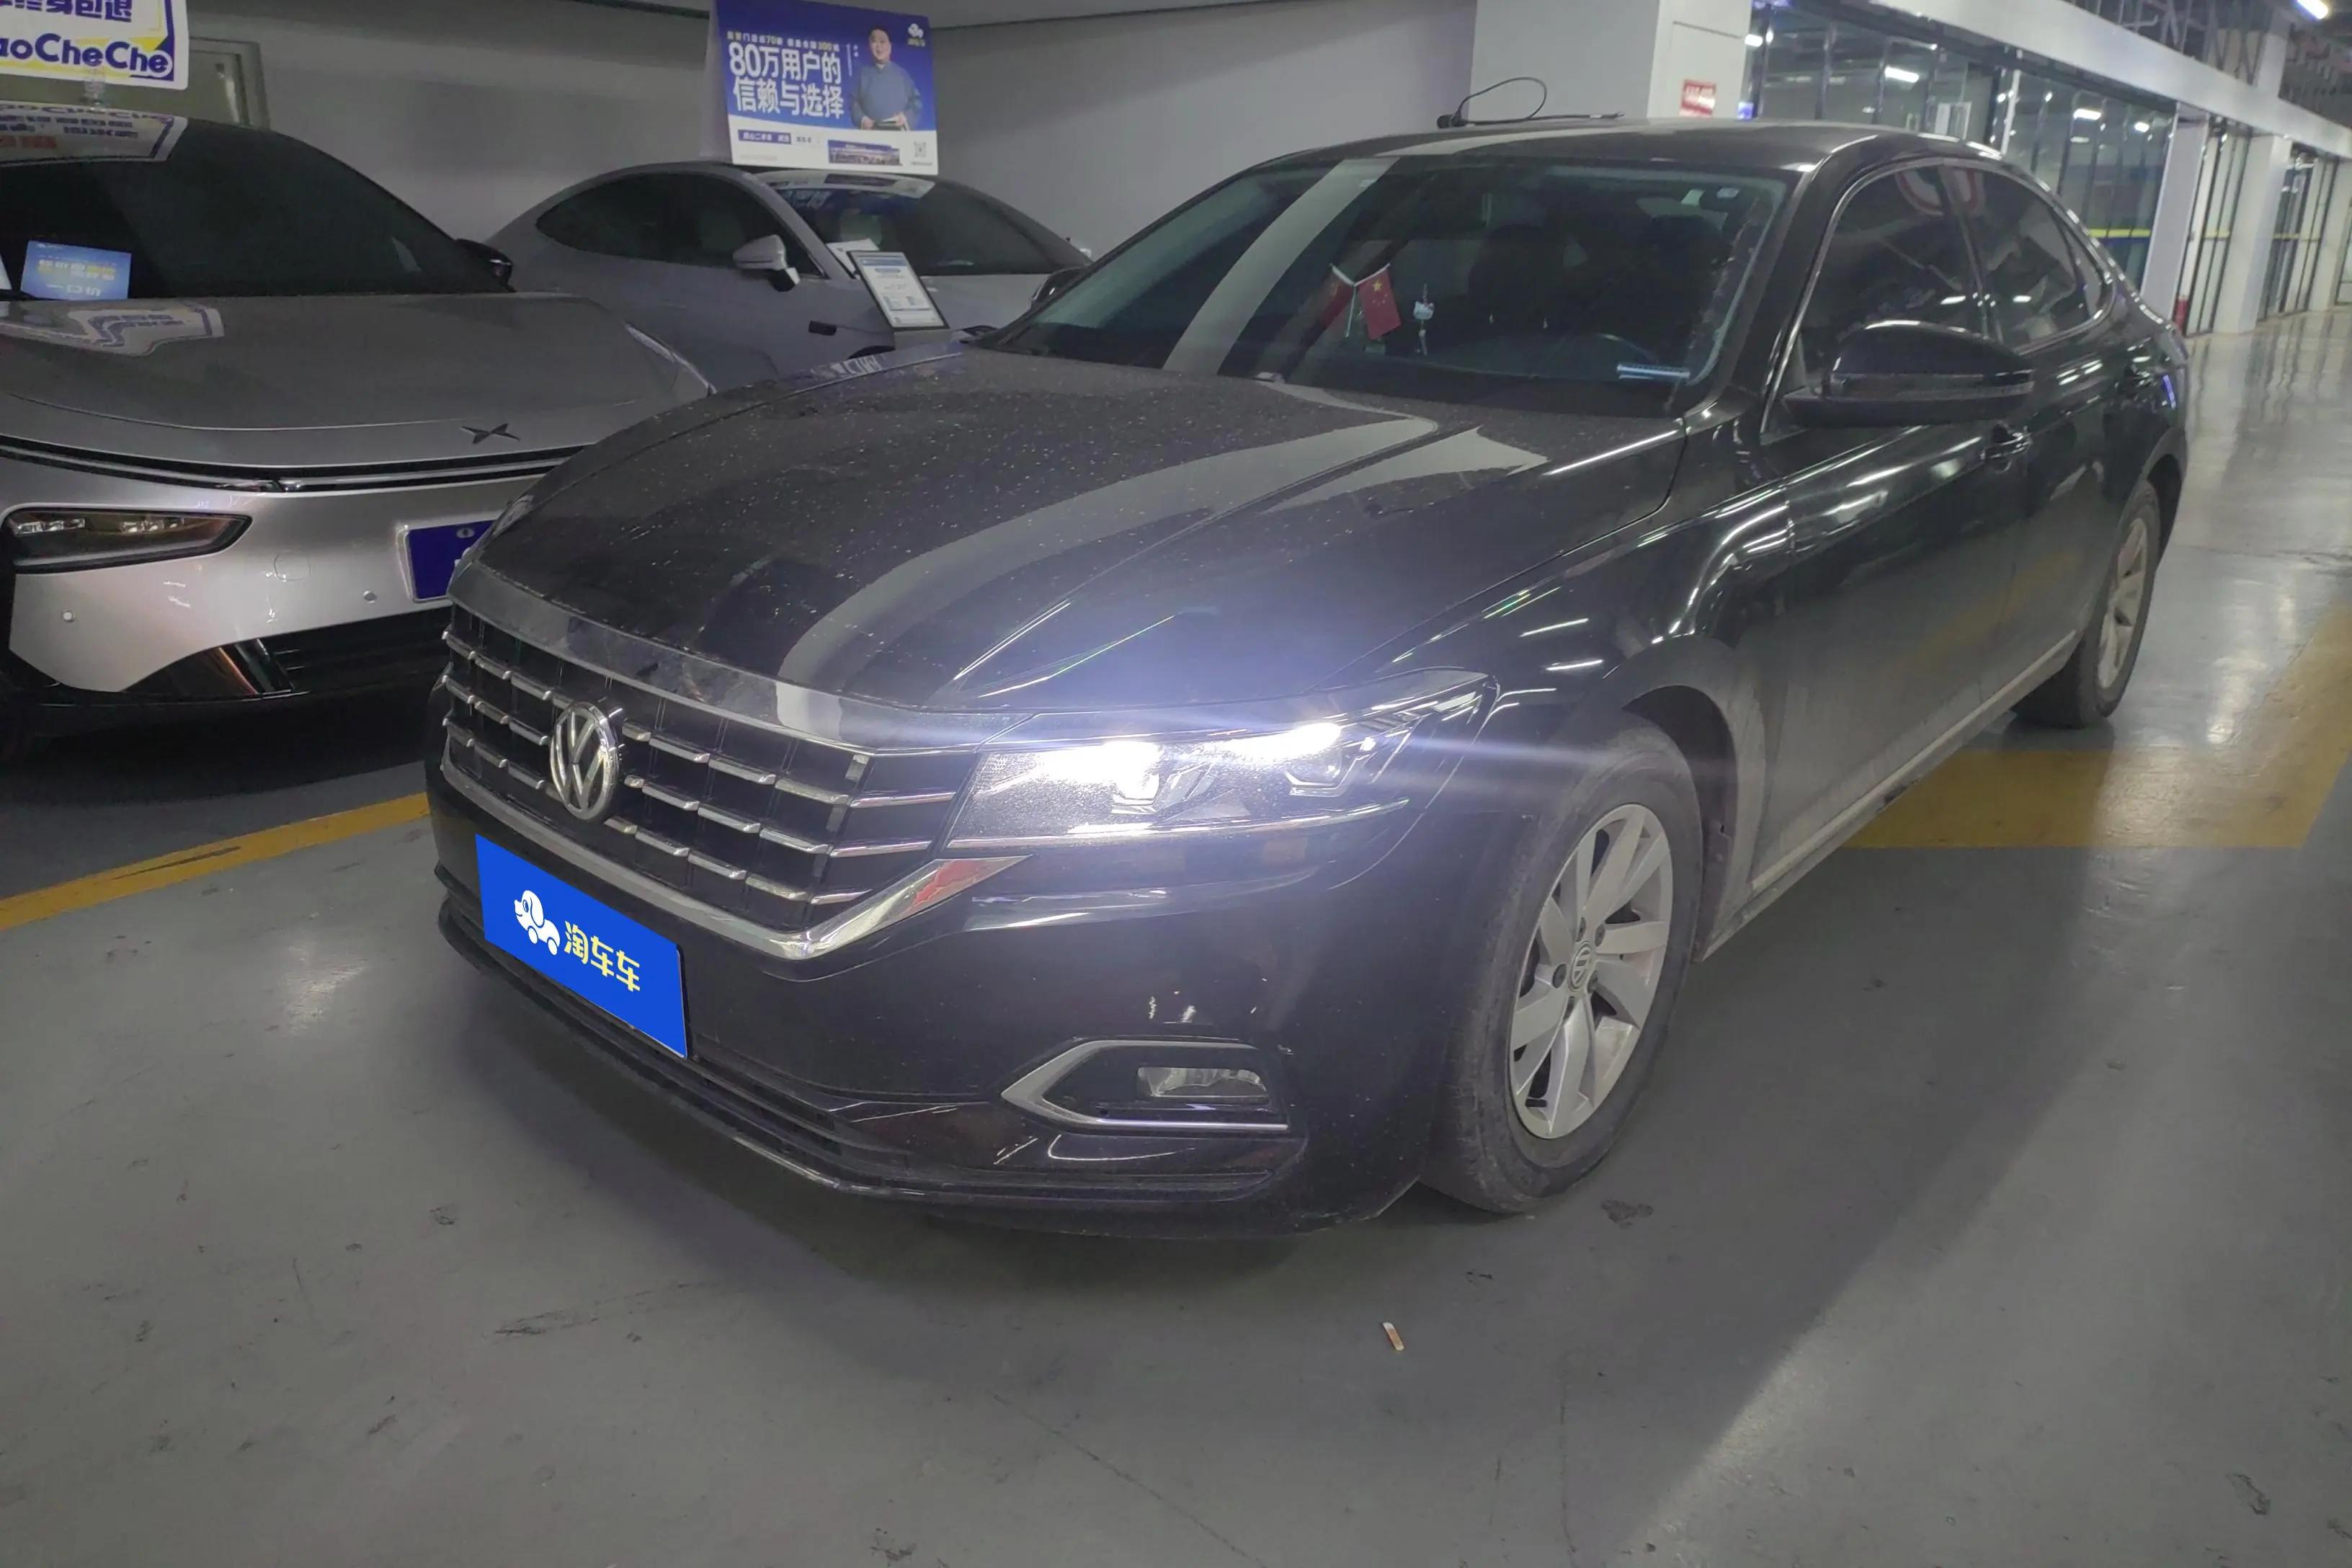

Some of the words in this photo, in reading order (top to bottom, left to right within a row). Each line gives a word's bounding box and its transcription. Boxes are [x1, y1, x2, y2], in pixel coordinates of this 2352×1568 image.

[729, 42, 841, 84] 80万用户的
[734, 77, 844, 119] 信赖与选择
